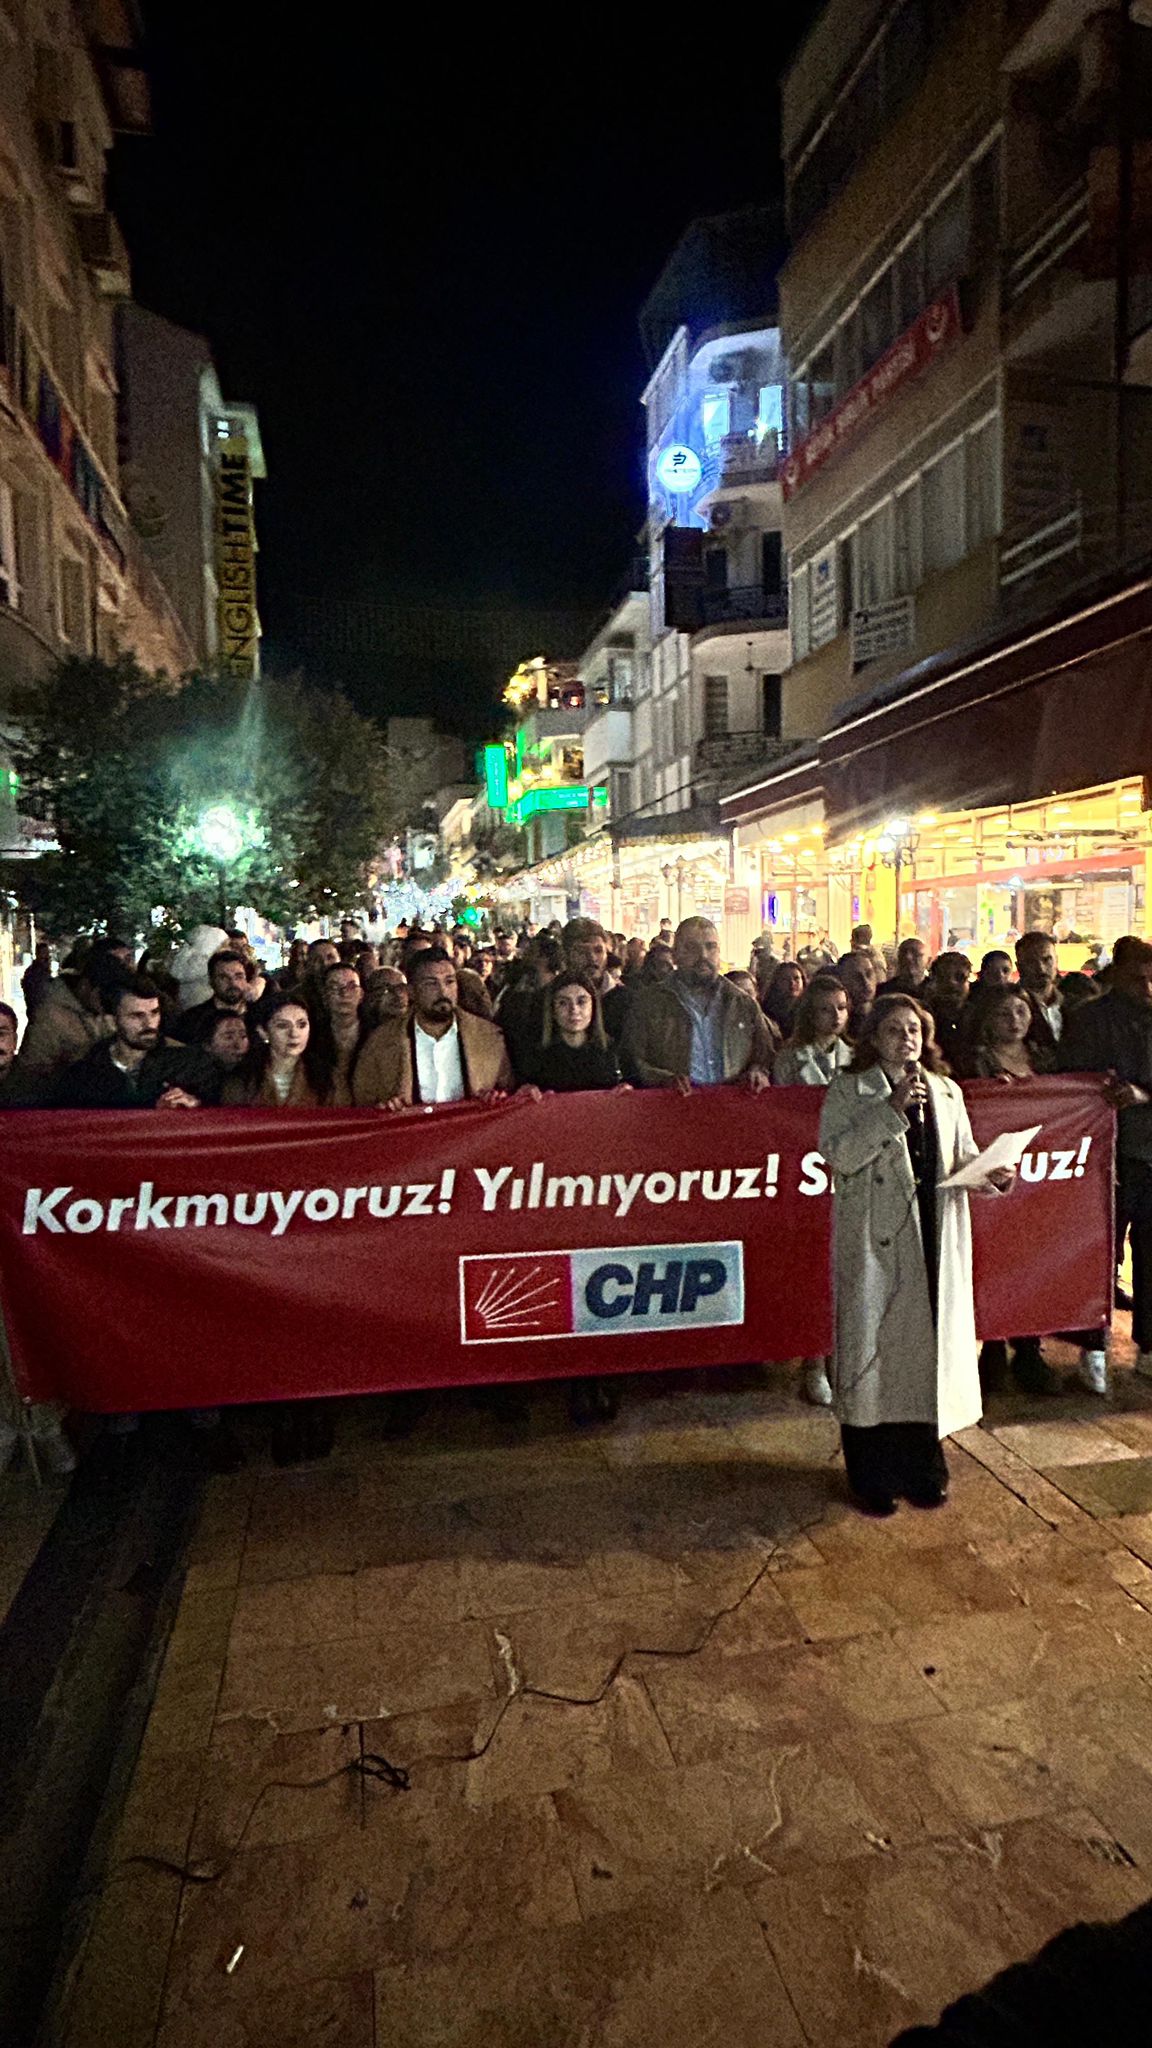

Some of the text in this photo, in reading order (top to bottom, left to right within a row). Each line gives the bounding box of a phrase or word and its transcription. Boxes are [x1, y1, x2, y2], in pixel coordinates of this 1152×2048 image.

[22, 1168, 456, 1236] Korkmuyoruz!
[474, 1152, 780, 1217] Yılmıyoruz!
[585, 1258, 727, 1320] CHP
